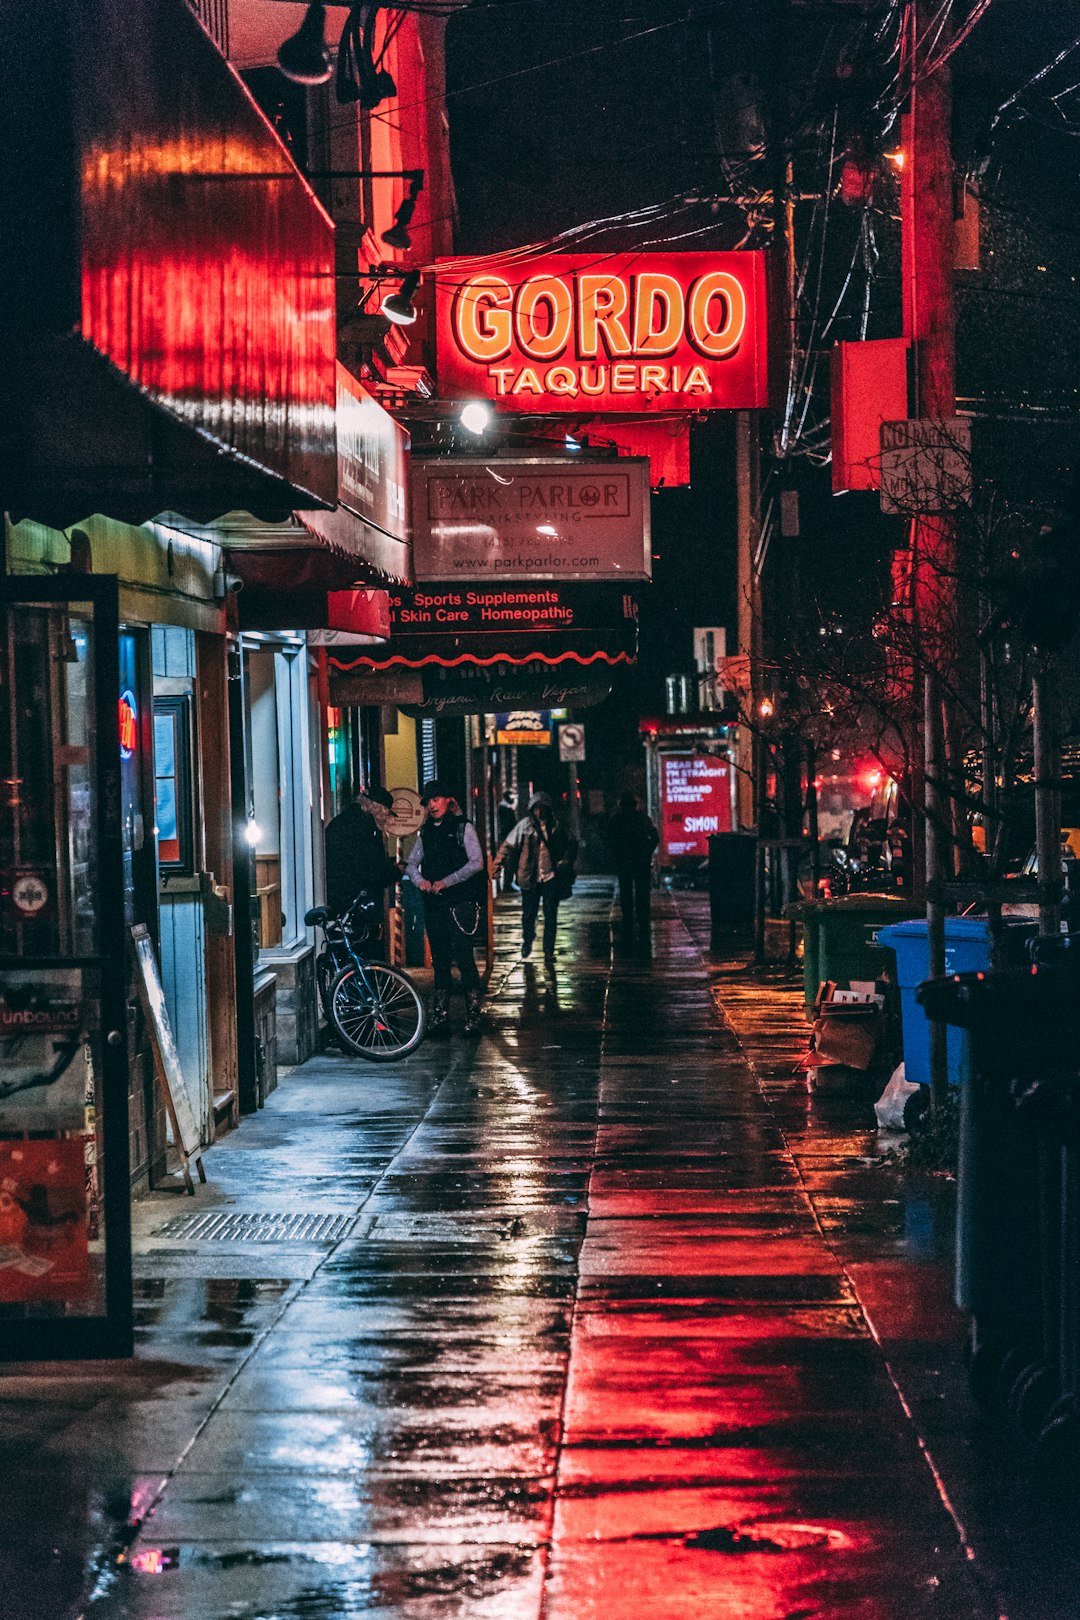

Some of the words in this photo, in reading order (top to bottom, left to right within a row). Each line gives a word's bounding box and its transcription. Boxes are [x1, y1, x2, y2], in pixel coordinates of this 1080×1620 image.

[452, 271, 747, 362] GORDO
[488, 365, 713, 398] TAQUERIA
[882, 424, 907, 447] NO
[439, 486, 502, 510] PARK
[520, 484, 619, 508] PARLOR
[477, 512, 582, 524] HAIRSTYLING
[453, 554, 599, 571] www.parkparlor.com
[414, 593, 462, 608] Sports
[466, 590, 560, 606] Supplements
[400, 609, 431, 623] Skin
[435, 608, 469, 622] Care
[481, 606, 574, 622] Homeopathic
[541, 684, 588, 703] Vegan
[666, 760, 692, 769] DEAR
[681, 768, 727, 777] STRAIGHT
[666, 777, 688, 786] LIKE
[666, 784, 712, 794] LOMBARD
[666, 793, 704, 803] STREET.
[683, 816, 719, 833] SIMON
